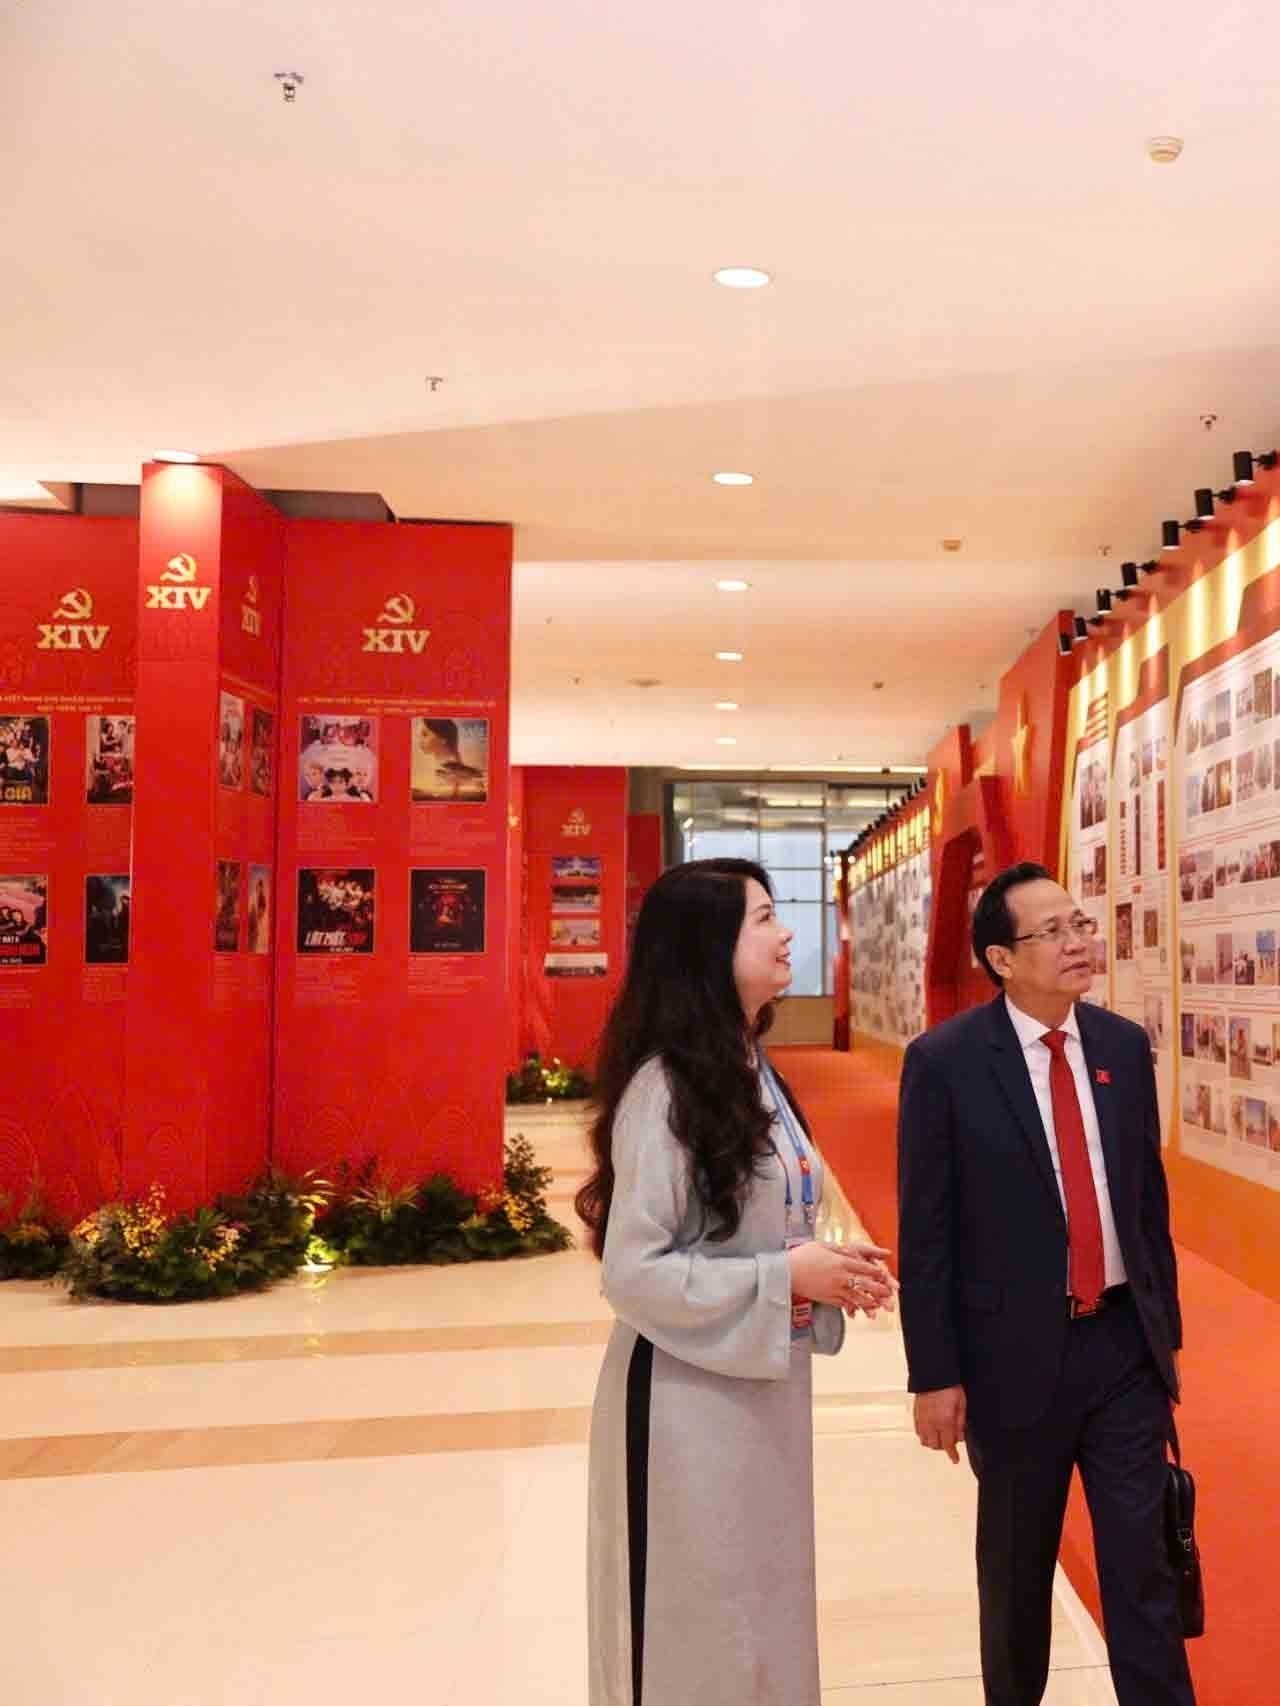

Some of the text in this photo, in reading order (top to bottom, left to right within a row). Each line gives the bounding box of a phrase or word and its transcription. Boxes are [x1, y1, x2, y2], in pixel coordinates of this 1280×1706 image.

[145, 585, 212, 610] XIV
[36, 624, 110, 650] XIV
[362, 628, 430, 654] XIV
